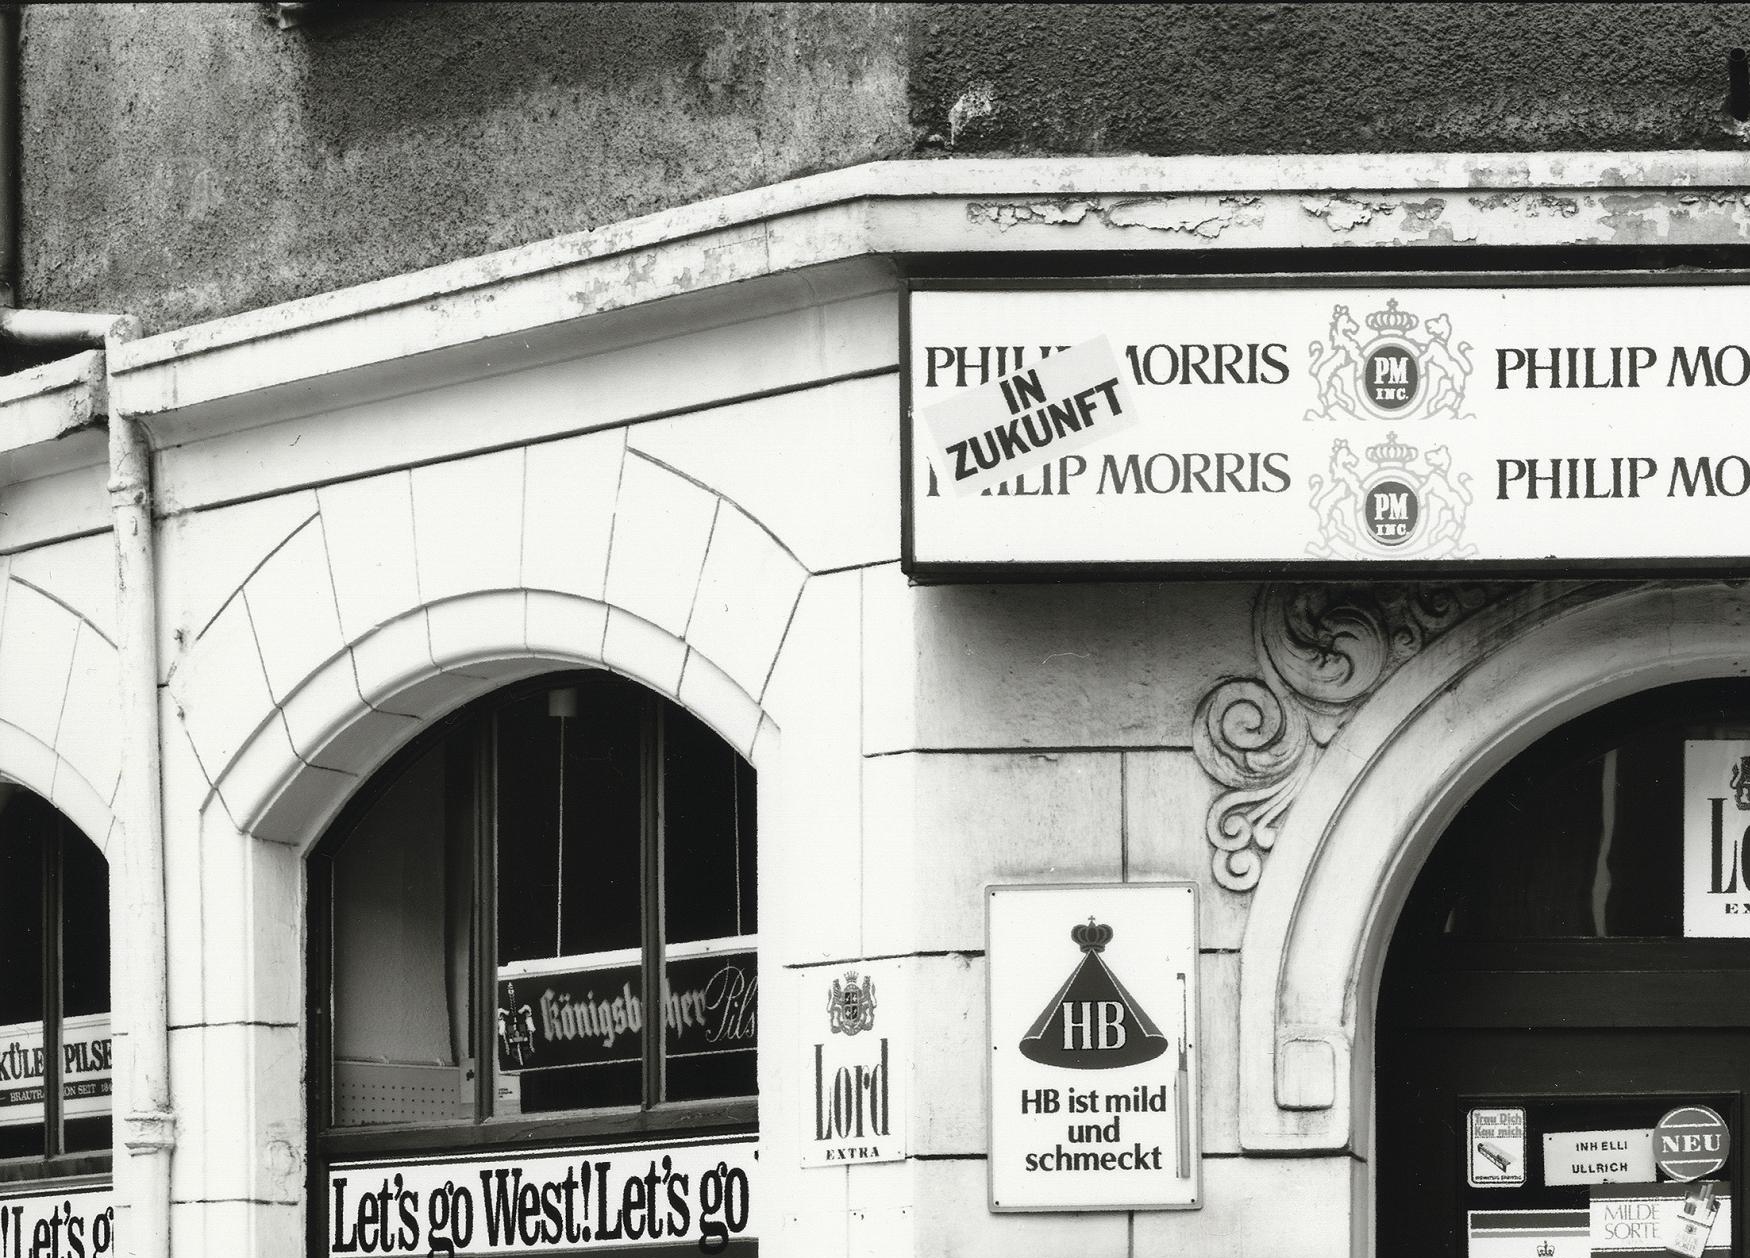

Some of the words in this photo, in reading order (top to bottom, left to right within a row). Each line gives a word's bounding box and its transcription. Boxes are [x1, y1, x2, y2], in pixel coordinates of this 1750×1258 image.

[925, 346, 1072, 387] PHI
[1374, 357, 1409, 386] PM
[1496, 345, 1657, 389] PHILIP
[1000, 368, 1047, 415] IN
[1376, 387, 1409, 401] INC.
[946, 377, 1122, 481] ZUKUNFT
[1096, 452, 1291, 495] MORRIS
[1496, 457, 1657, 500] PHILIP
[1374, 492, 1409, 520] PM
[1376, 523, 1410, 536] INC.
[540, 977, 706, 1048] Königsbher
[1061, 1000, 1127, 1051] HB
[63, 1038, 112, 1074] PILSE
[815, 1039, 891, 1142] Lord
[1021, 1090, 1061, 1114] HB
[1069, 1088, 1100, 1113] ist
[1106, 1086, 1167, 1113] mild
[1067, 1117, 1121, 1144] und
[1474, 1126, 1495, 1137] Kau
[1498, 1125, 1522, 1137] mich
[1475, 1112, 1497, 1124] Trau
[1499, 1112, 1522, 1124] Dich
[826, 1146, 881, 1161] EXTRA
[1661, 1134, 1722, 1152] NEU
[1025, 1144, 1163, 1173] schmeckt
[1572, 1162, 1628, 1174] ULLRICH
[331, 1172, 419, 1253] Let's
[480, 1160, 592, 1248] West!
[592, 1155, 691, 1242] Let's
[698, 1160, 749, 1255] go
[1604, 1203, 1660, 1221] MILDE
[1604, 1222, 1660, 1240] SORTE
